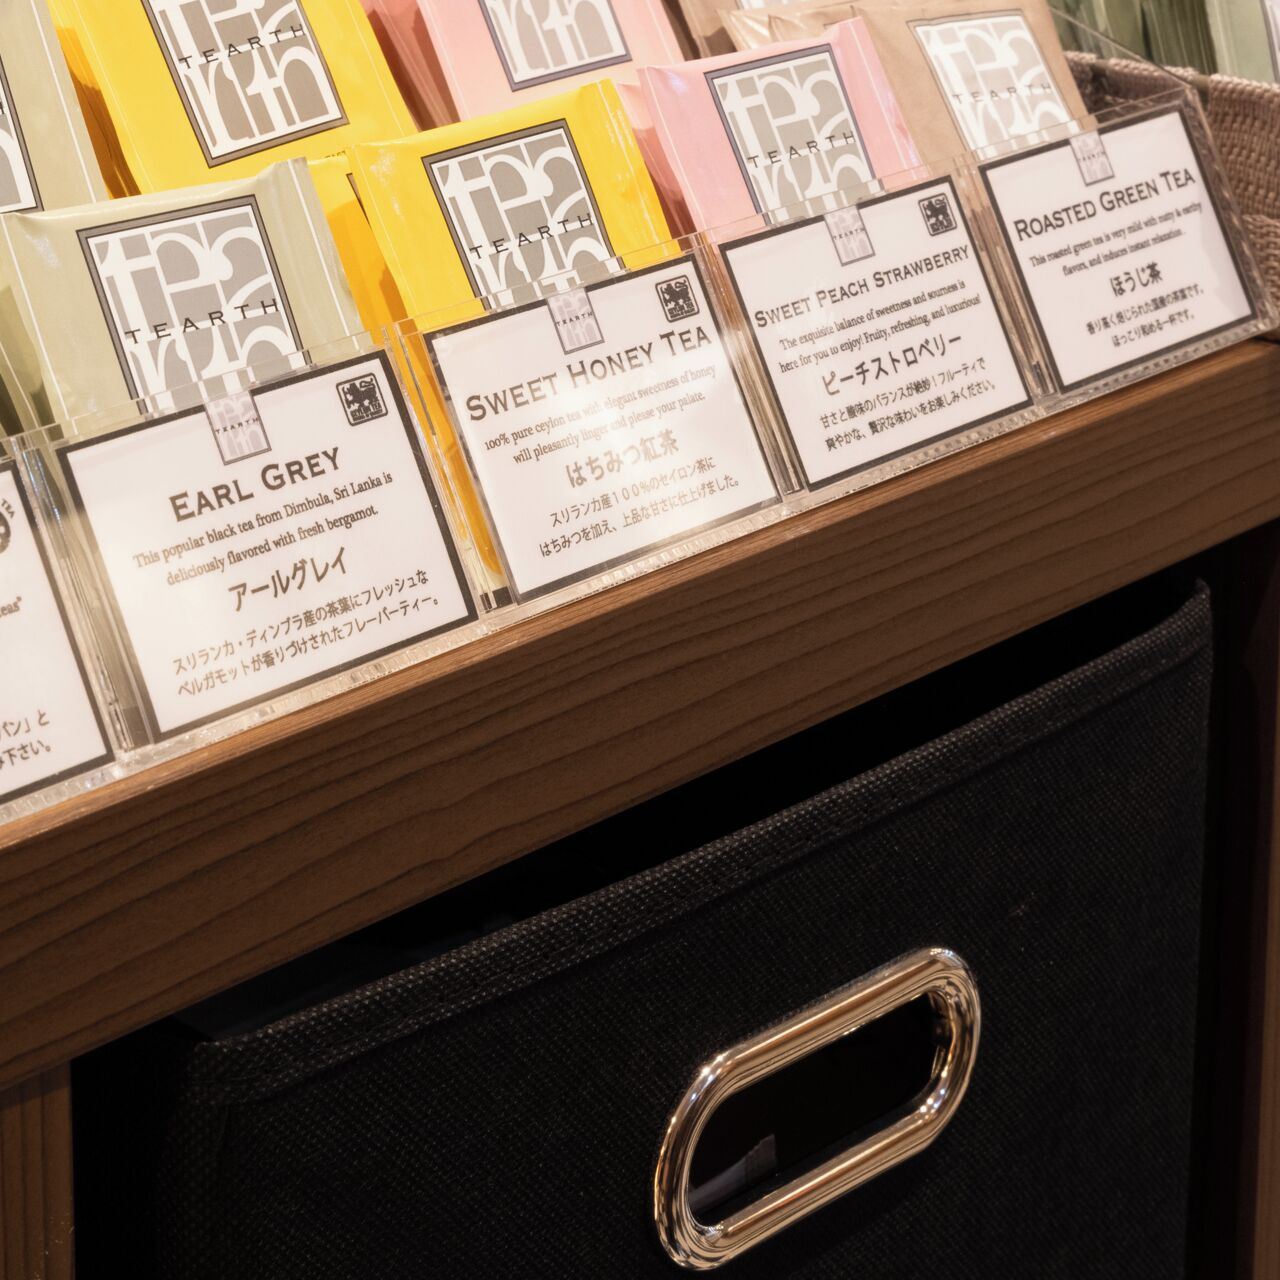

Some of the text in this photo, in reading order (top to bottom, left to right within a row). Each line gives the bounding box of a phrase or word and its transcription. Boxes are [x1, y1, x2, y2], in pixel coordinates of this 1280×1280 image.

[179, 23, 307, 71] TEARTH
[952, 83, 1054, 104] TEARTH
[748, 131, 857, 168] TEARTH
[470, 213, 595, 260] TEARTH
[1012, 167, 1197, 242] ROASTED GREEN TEA
[753, 244, 969, 329] SWEET PEACH STRAWBERRY
[1109, 261, 1163, 297] ほうじ茶
[125, 298, 280, 344] TEARTH
[778, 279, 966, 351] The exquisite balance of sweetness and sourness is
[778, 293, 982, 374] here for you to enjoy! Fruity, refreshing, and luxurious!
[465, 325, 713, 422] SWEET HONEY TEA
[821, 333, 962, 396] ピーチストロベリー
[484, 432, 511, 451] 100%
[510, 426, 535, 446] pure
[534, 416, 566, 435] ceylon
[565, 410, 583, 423] tea
[604, 390, 638, 411] elegant
[679, 370, 691, 385] of
[688, 364, 717, 382] honey
[512, 447, 533, 465] will
[532, 433, 579, 462] pleasantly
[578, 424, 609, 442] linger
[627, 407, 656, 429] please
[655, 400, 678, 420] your
[676, 391, 707, 412] palate.
[168, 446, 340, 523] EARL GREY
[564, 427, 680, 489] はちみつ紅茶
[0, 498, 16, 520] TEA
[132, 471, 393, 568] This popular black tea from Dimbula, Sri Lanka is
[166, 505, 379, 586] deliciously flavored with fresh bergamot.
[227, 545, 347, 612] アールグレイ
